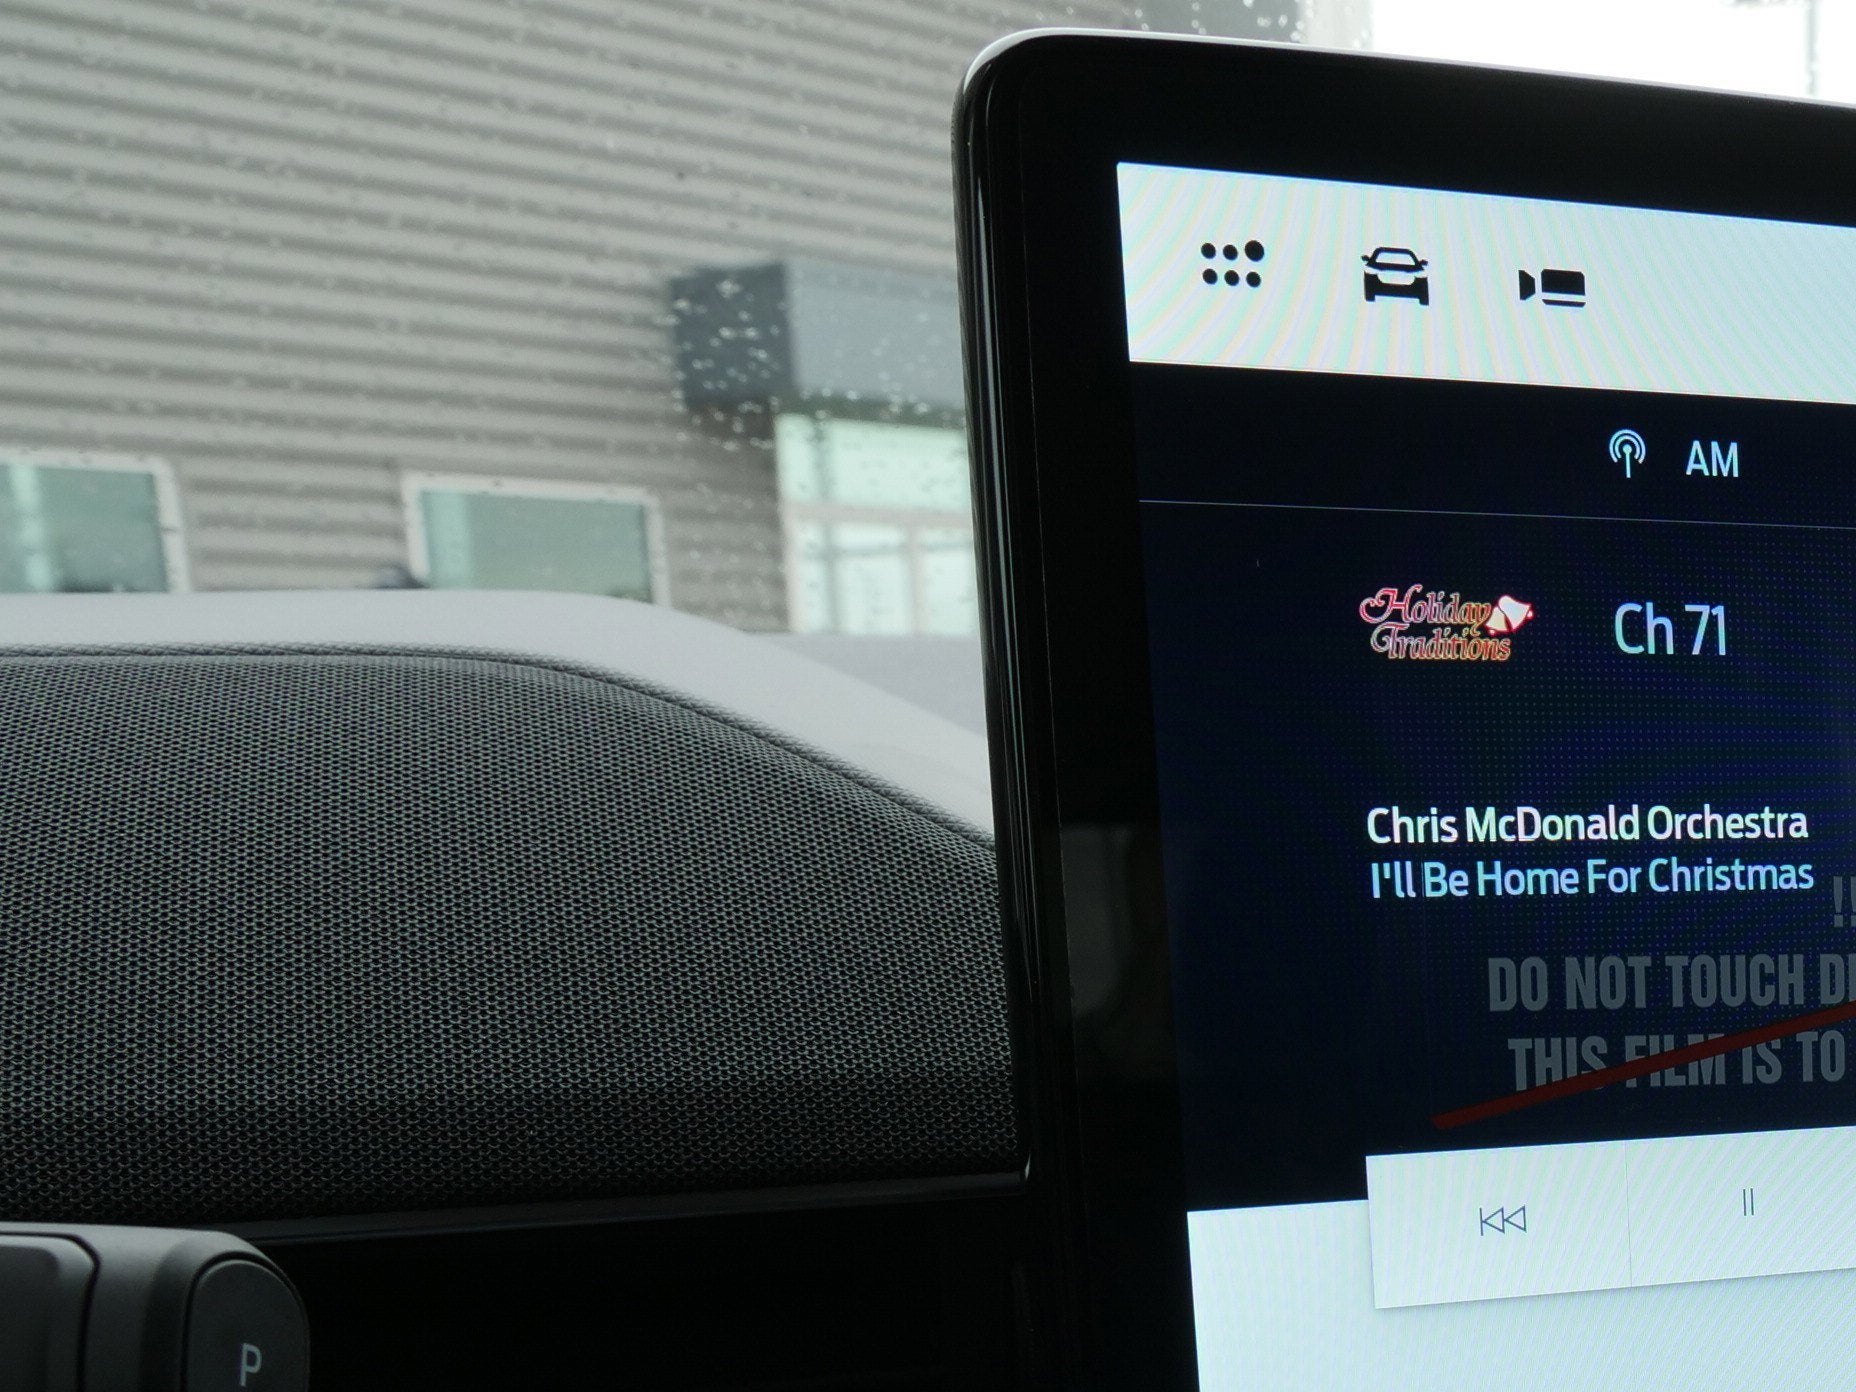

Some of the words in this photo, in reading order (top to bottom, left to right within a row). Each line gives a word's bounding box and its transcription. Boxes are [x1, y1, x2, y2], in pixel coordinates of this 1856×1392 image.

[1685, 440, 1740, 478] AM
[1359, 584, 1493, 636] Holiday
[1614, 602, 1674, 655] Ch
[1684, 605, 1726, 656] 71
[1371, 622, 1511, 661] Traditions
[1367, 806, 1458, 844] Chris
[1466, 804, 1639, 842] McDonald
[1647, 803, 1808, 840] Orchestra
[1370, 859, 1416, 898] I'll
[1423, 861, 1469, 898] Be
[1477, 860, 1580, 896] Home
[1586, 858, 1643, 894] For
[1648, 857, 1815, 892] Christmas
[1488, 956, 1548, 1012] DO
[1565, 954, 1652, 1011] NOT
[1665, 952, 1804, 1007] TOUCH
[1507, 1035, 1608, 1091] THIS
[1624, 1033, 1726, 1088] FILM
[1742, 1032, 1782, 1085] IS
[1796, 1030, 1846, 1082] TO
[239, 1342, 262, 1388] P
